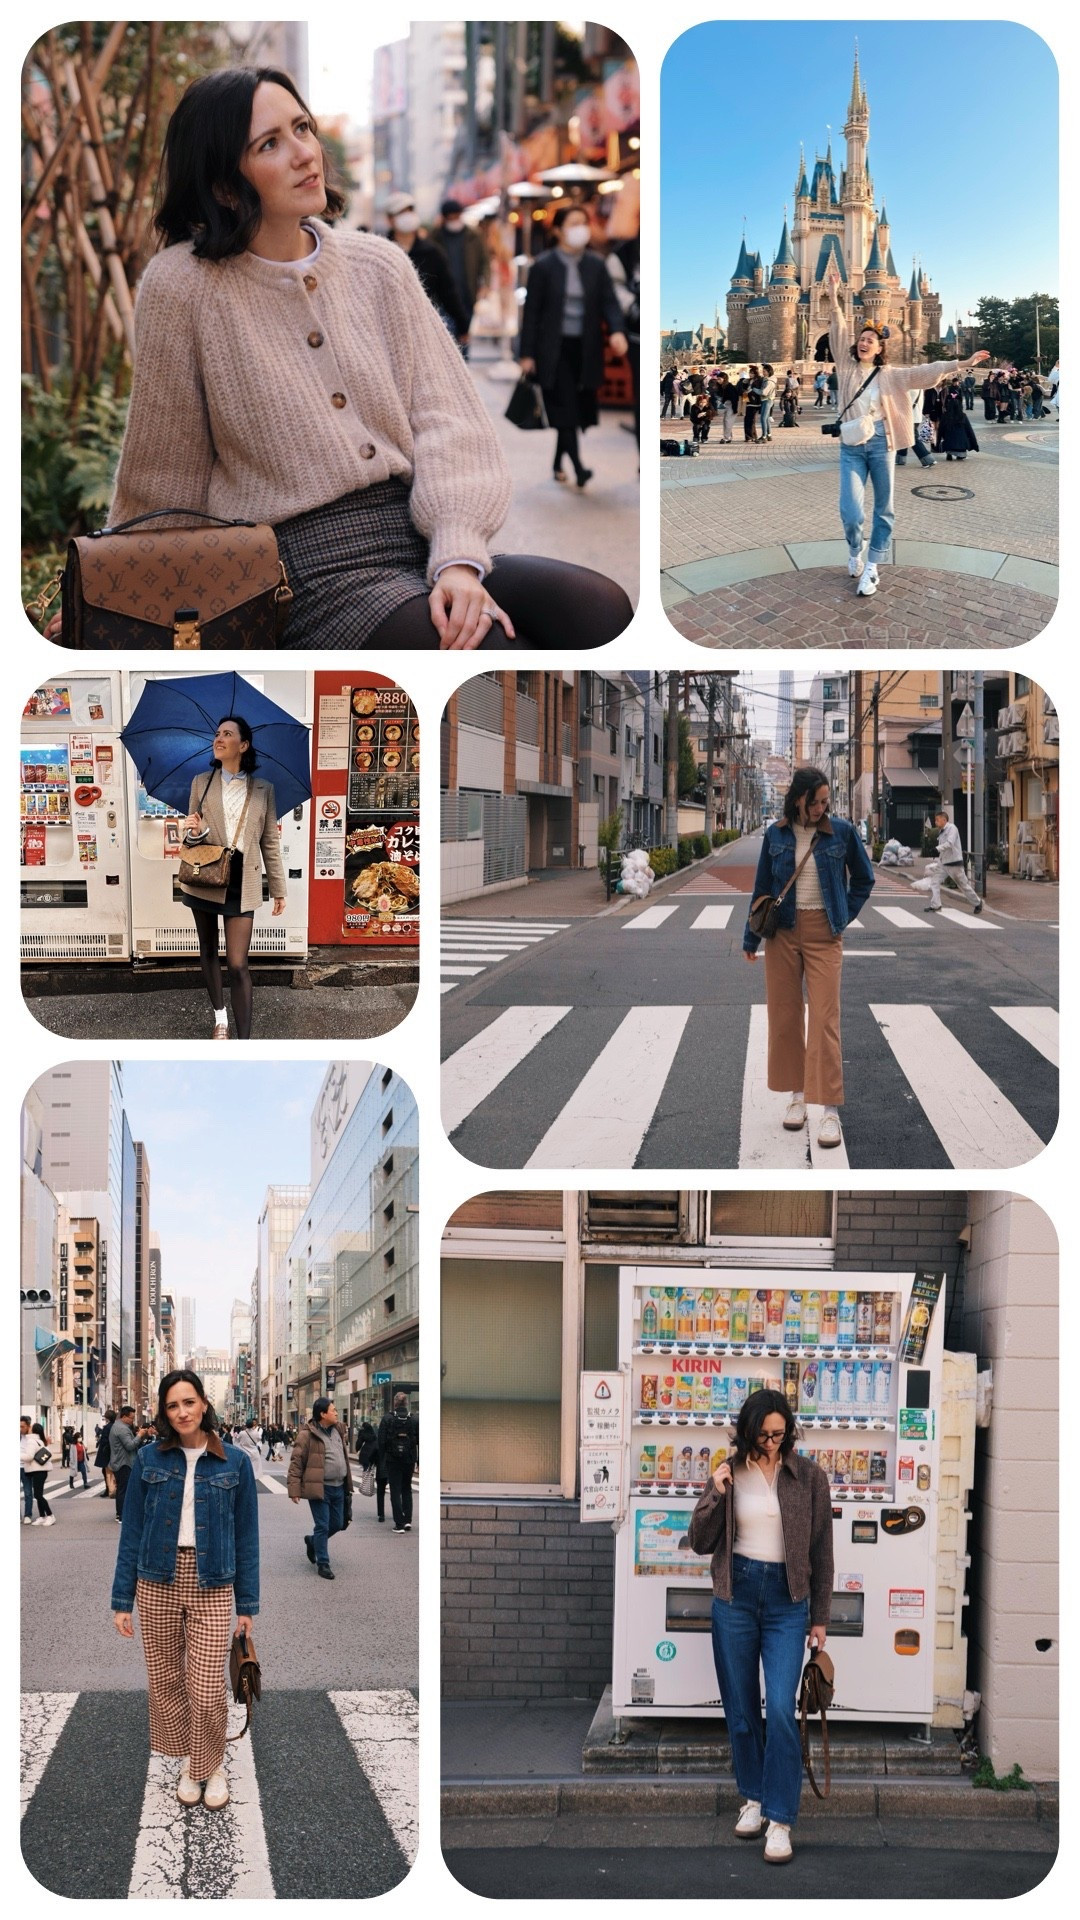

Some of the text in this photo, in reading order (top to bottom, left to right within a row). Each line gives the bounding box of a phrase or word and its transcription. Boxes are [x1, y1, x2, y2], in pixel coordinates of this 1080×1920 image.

[374, 692, 409, 704] ¥880
[346, 914, 371, 922] 980円
[149, 1261, 157, 1305] BOUCHERON
[672, 1359, 722, 1373] KIRIN
[586, 1407, 620, 1416] 監視カメラ
[596, 1422, 618, 1430] 稼働中
